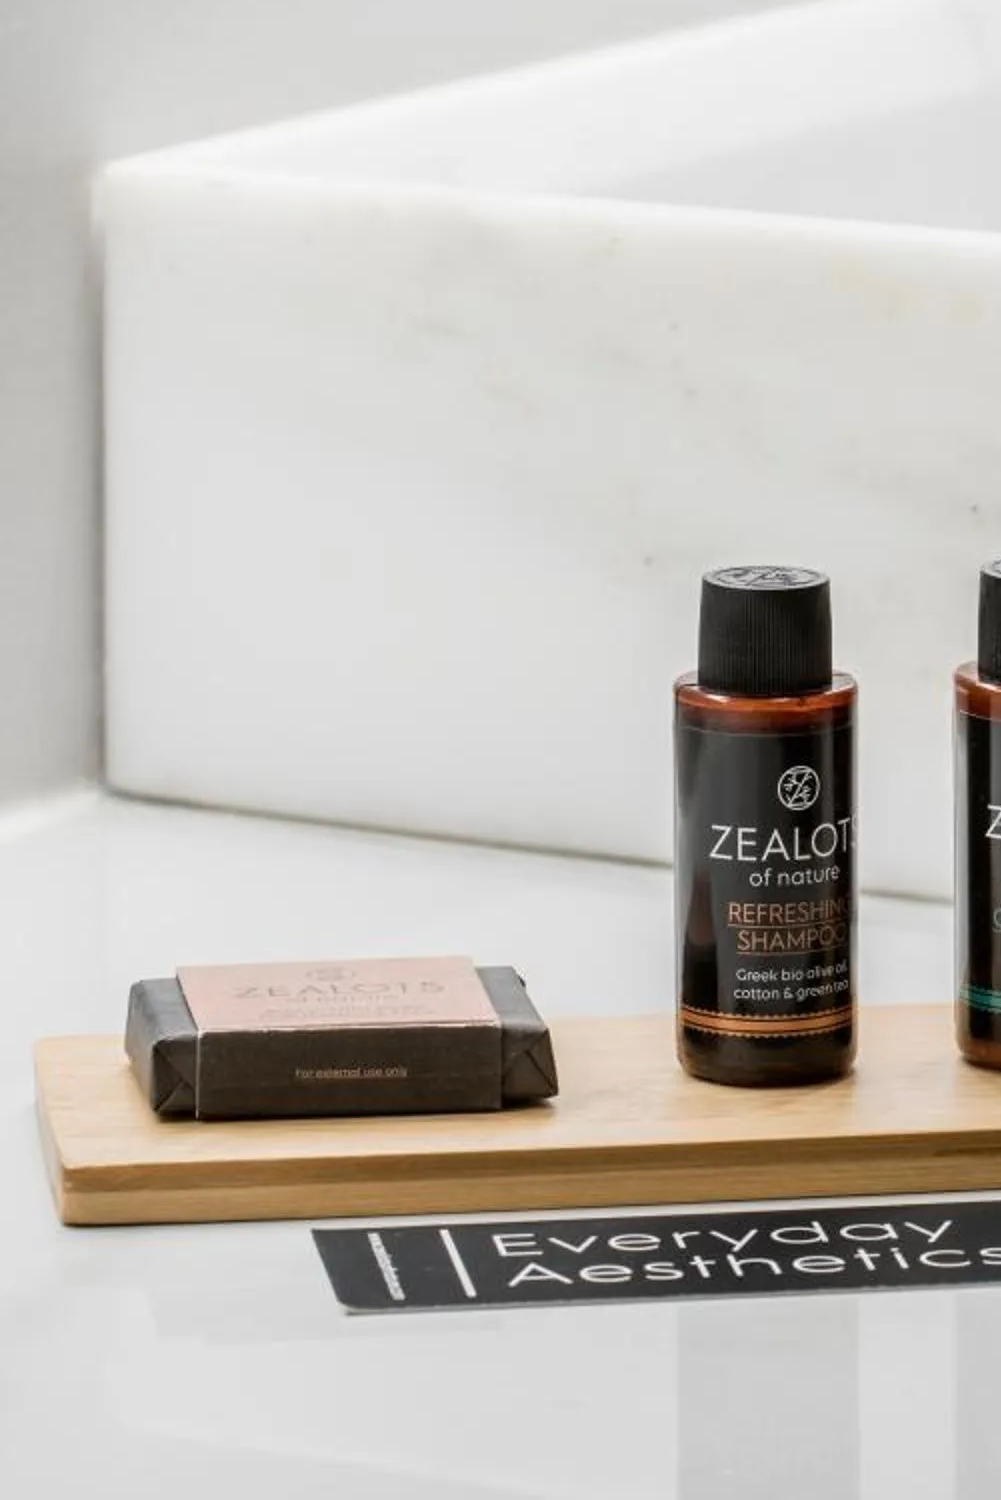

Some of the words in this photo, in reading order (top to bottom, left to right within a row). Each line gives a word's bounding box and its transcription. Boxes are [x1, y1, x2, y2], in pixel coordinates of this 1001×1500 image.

[749, 867, 772, 887] of
[777, 865, 840, 886] nature
[735, 968, 778, 981] Greek
[781, 968, 804, 982] bio
[733, 987, 780, 1001] cotton
[783, 987, 794, 1000] &
[796, 983, 833, 1002] green
[492, 1220, 952, 1256] Everyday
